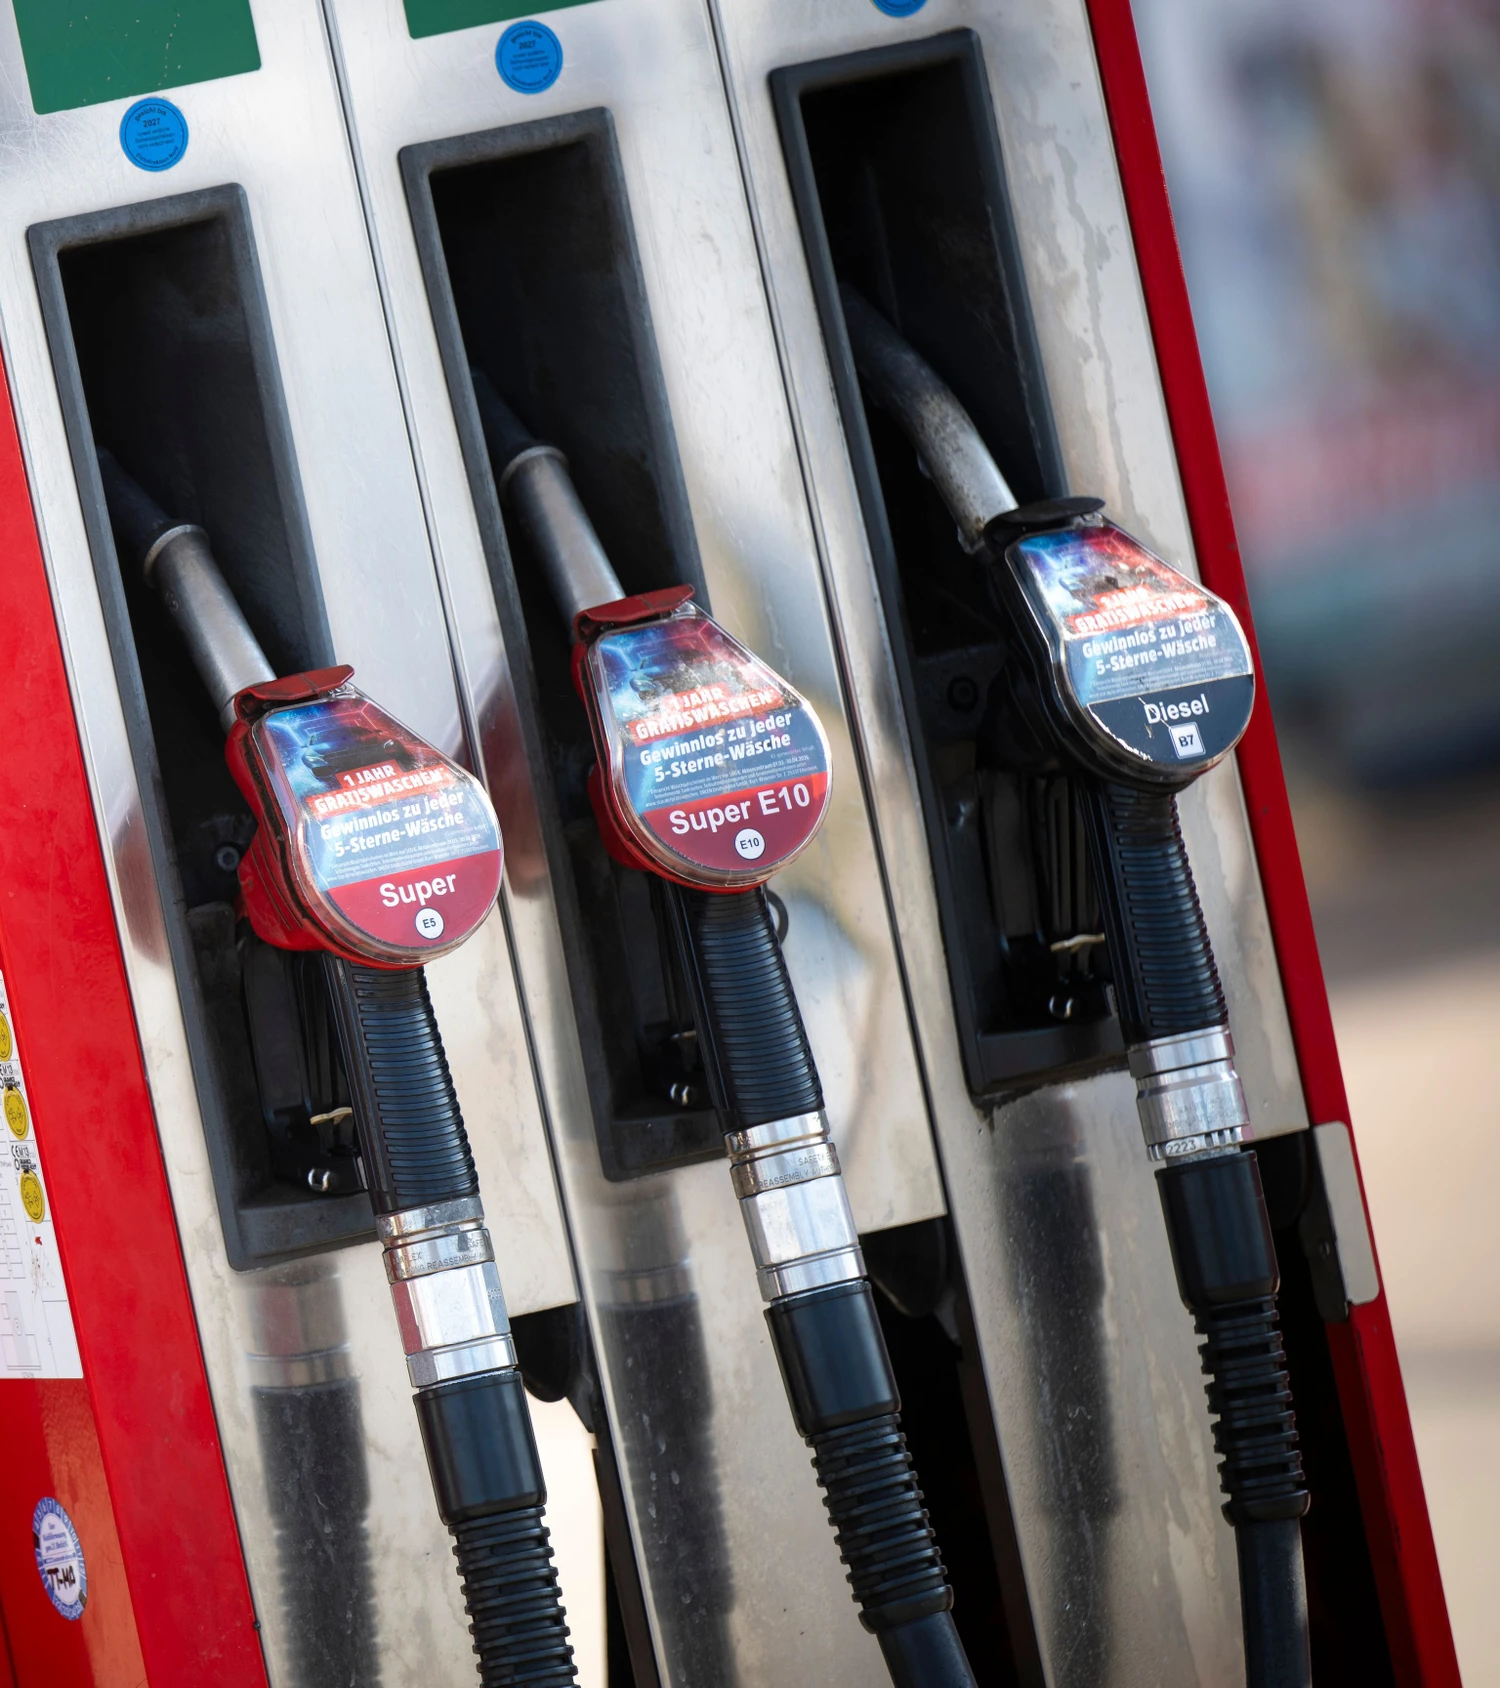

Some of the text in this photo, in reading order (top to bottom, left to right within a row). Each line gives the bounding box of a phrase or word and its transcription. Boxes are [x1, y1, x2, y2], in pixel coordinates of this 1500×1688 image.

[143, 117, 160, 127] 2027
[1082, 615, 1216, 658] Gewinnlos zu jeder
[1094, 632, 1216, 676] 5-Sterne-Wäsche
[683, 686, 725, 709] JAHR
[1143, 693, 1210, 724] Diesel
[640, 712, 792, 765] Gewinnlos zu jeder
[1178, 734, 1194, 747] B7
[654, 733, 790, 783] 5-Sterne-Wäsche
[343, 764, 397, 787] 1 JAHR
[320, 791, 464, 839] Gewinnlos zu jeder
[669, 801, 751, 834] Super
[758, 783, 810, 815] E10
[334, 809, 464, 857] 5-Sterne-Wäsche
[739, 837, 759, 850] E10
[379, 873, 457, 907] Super
[422, 917, 437, 929] E5
[1166, 1139, 1197, 1154] 2223
[759, 1169, 809, 1188] REASSEMBLY
